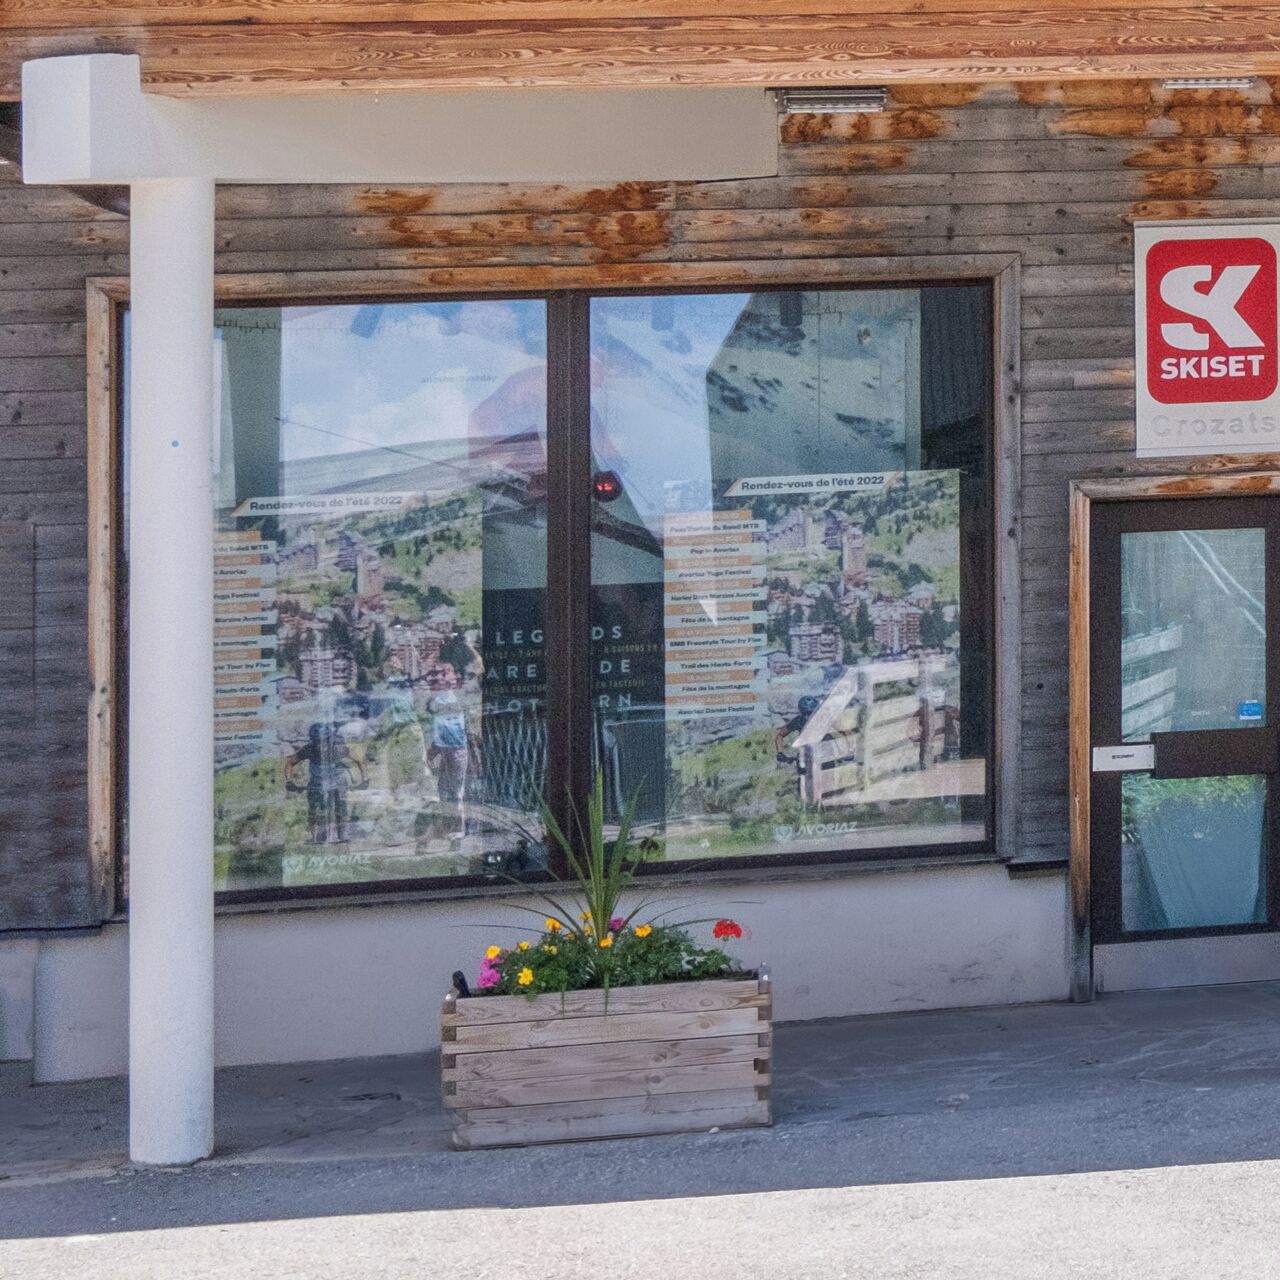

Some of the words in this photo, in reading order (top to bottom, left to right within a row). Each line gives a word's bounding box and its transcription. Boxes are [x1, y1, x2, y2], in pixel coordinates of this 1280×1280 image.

[1160, 355, 1265, 380] SKISET
[1152, 411, 1276, 437] Crozats
[741, 479, 814, 490] Rendez-vous
[816, 478, 830, 487] de
[832, 477, 855, 487] l'été
[857, 476, 885, 485] 2022
[250, 499, 327, 511] Rendez-vous
[329, 497, 344, 507] de
[374, 496, 403, 505] 2022
[486, 663, 538, 680] ARE
[796, 821, 858, 835] AVORIAZ
[307, 854, 371, 867] AVORIAZ
